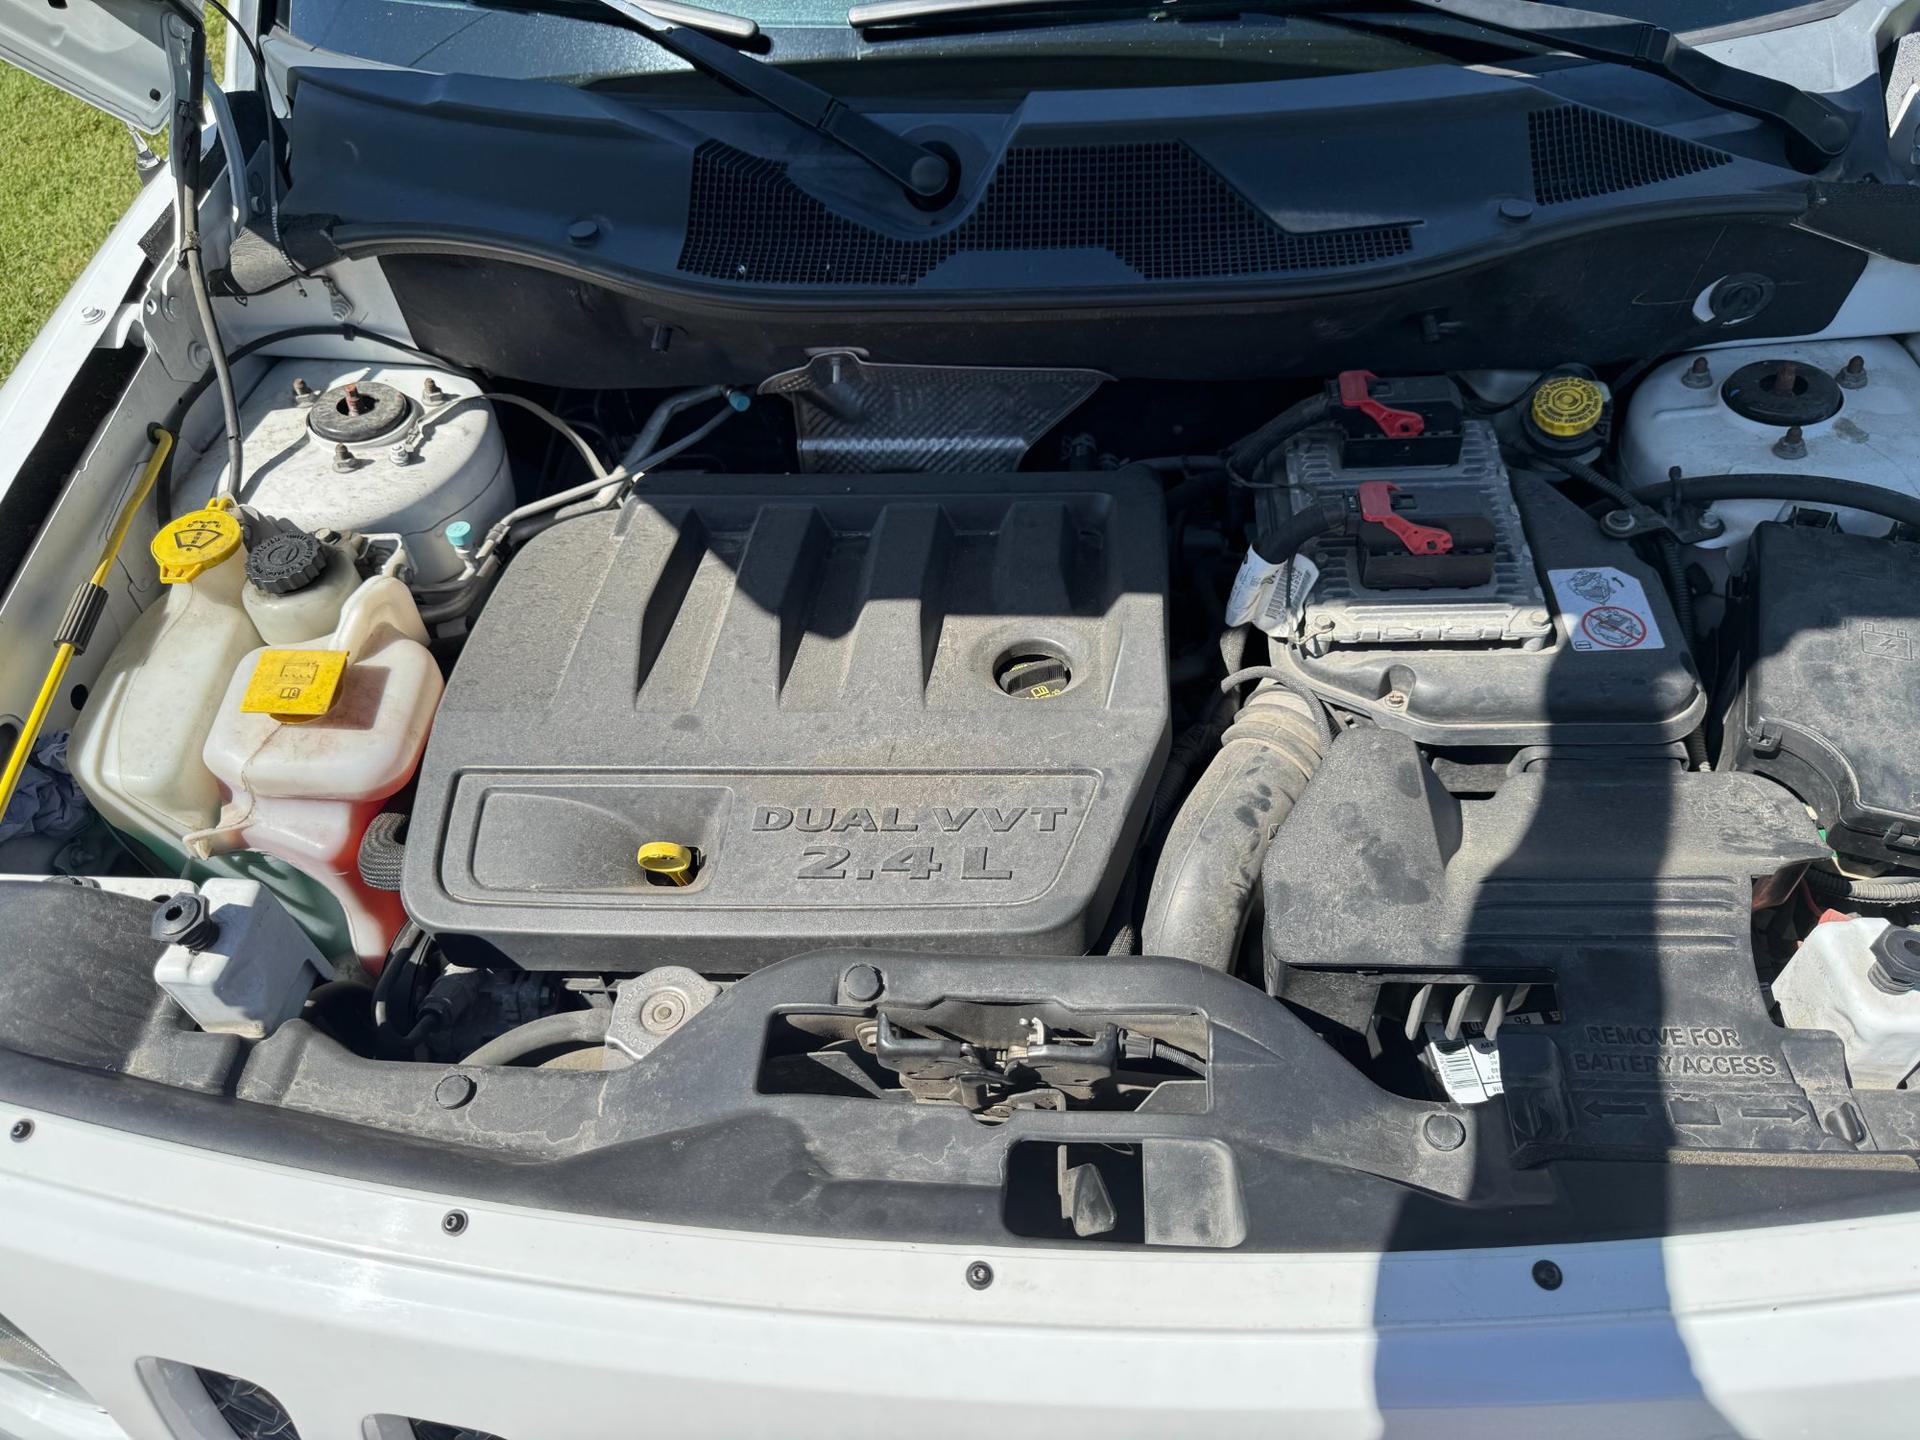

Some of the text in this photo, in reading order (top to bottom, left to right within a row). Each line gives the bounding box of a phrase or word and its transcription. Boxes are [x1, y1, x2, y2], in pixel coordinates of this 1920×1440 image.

[752, 806, 1067, 832] DUAL VVT
[797, 846, 1012, 880] 2.4 L
[1585, 1026, 1741, 1047] REMOVE FOR
[1573, 1052, 1777, 1075] BATTERY ACCESS
